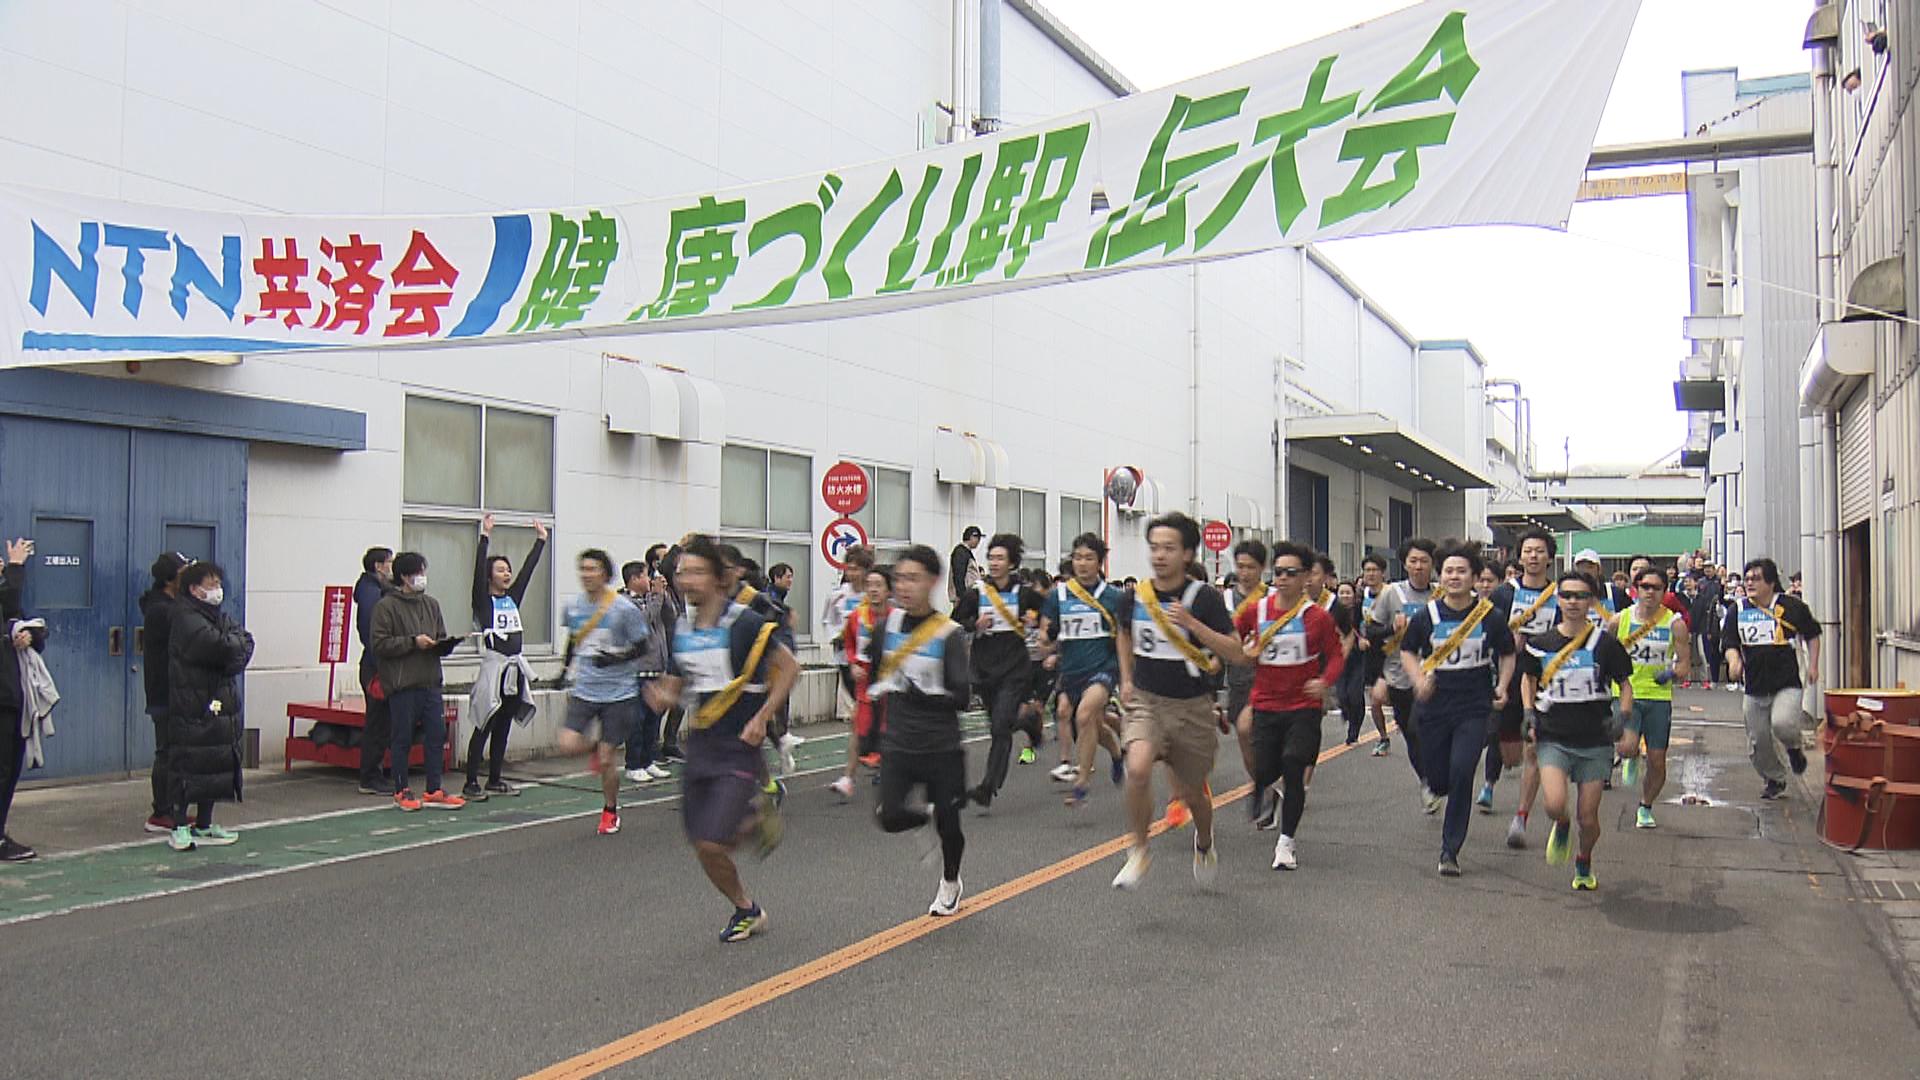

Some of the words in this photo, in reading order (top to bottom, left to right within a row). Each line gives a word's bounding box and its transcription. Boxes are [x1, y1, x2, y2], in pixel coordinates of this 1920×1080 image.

[827, 484, 862, 496] 防火水槽
[1740, 625, 1775, 644] 12-1
[1438, 645, 1480, 665] 0-1
[1631, 643, 1666, 663] 24-1
